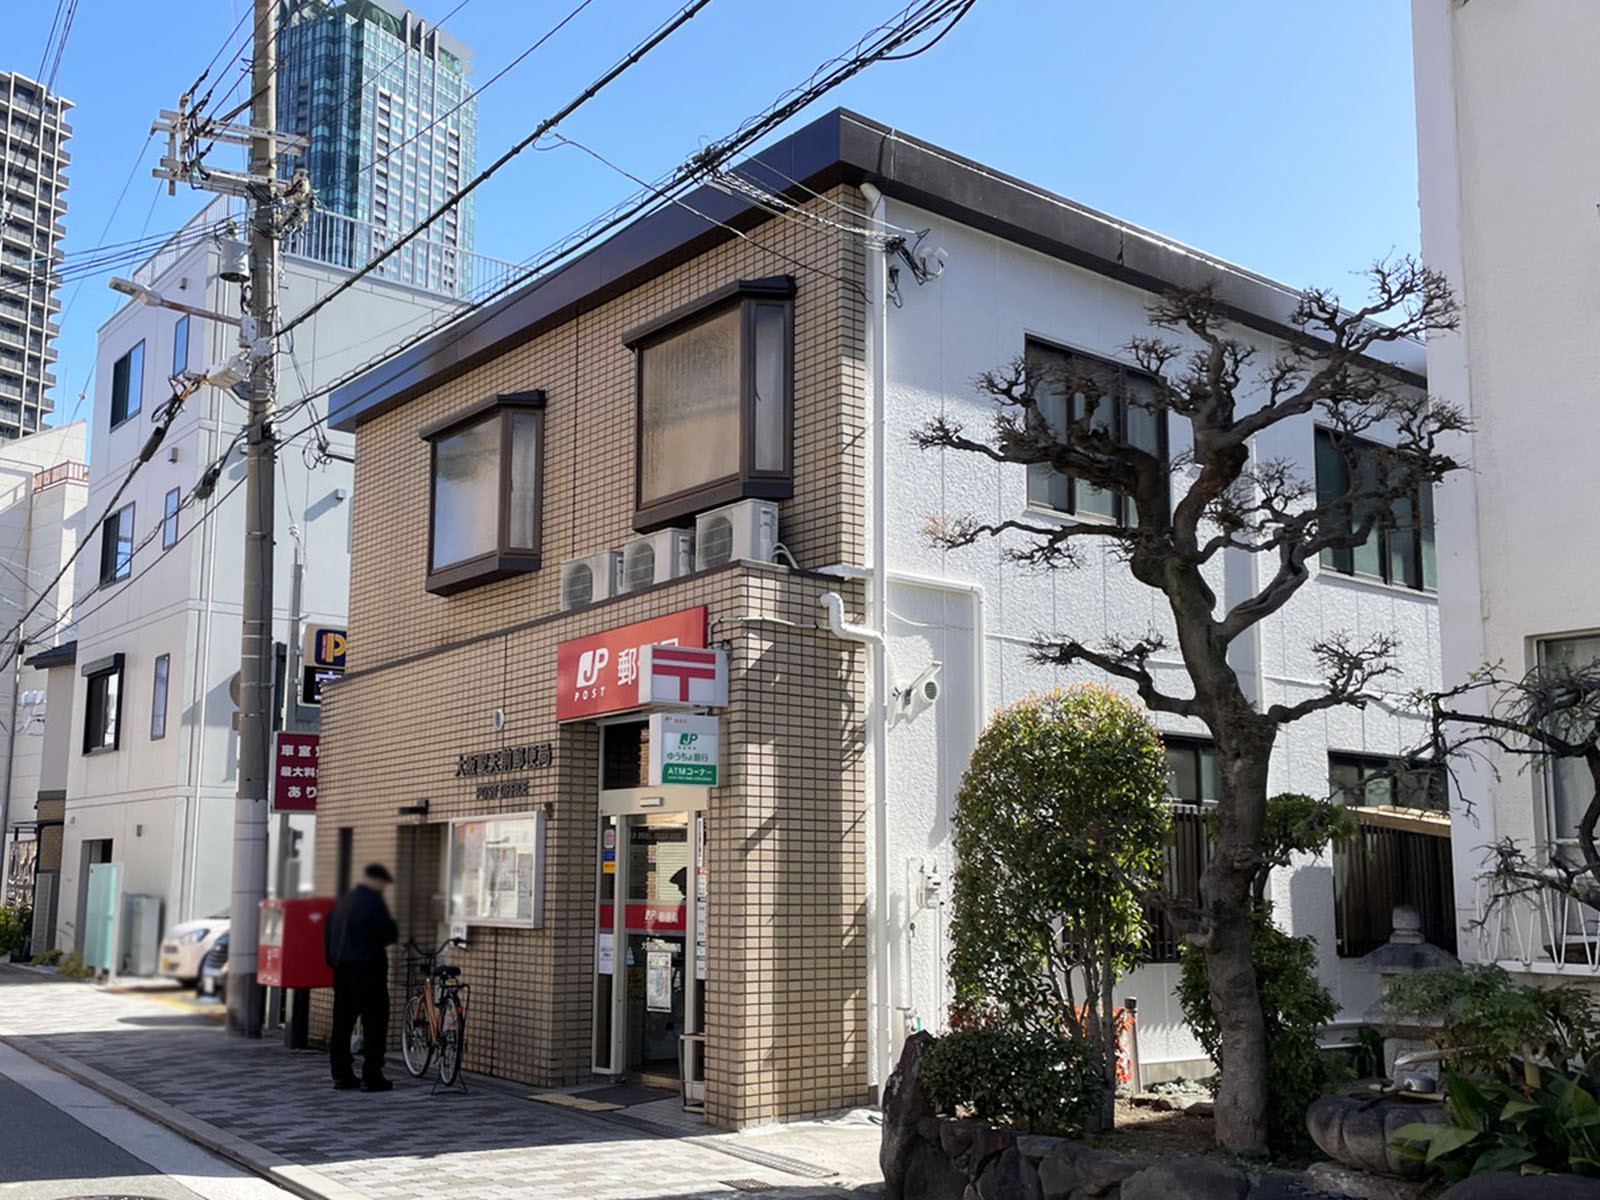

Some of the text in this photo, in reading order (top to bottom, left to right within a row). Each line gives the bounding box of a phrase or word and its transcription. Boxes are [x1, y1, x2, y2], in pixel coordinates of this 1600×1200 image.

[326, 633, 347, 663] P
[574, 686, 606, 702] POST
[667, 752, 709, 762] ゆうちょ銀行
[280, 766, 319, 778] 最大料
[667, 767, 713, 776] ATMコーナー
[287, 786, 317, 799] あり
